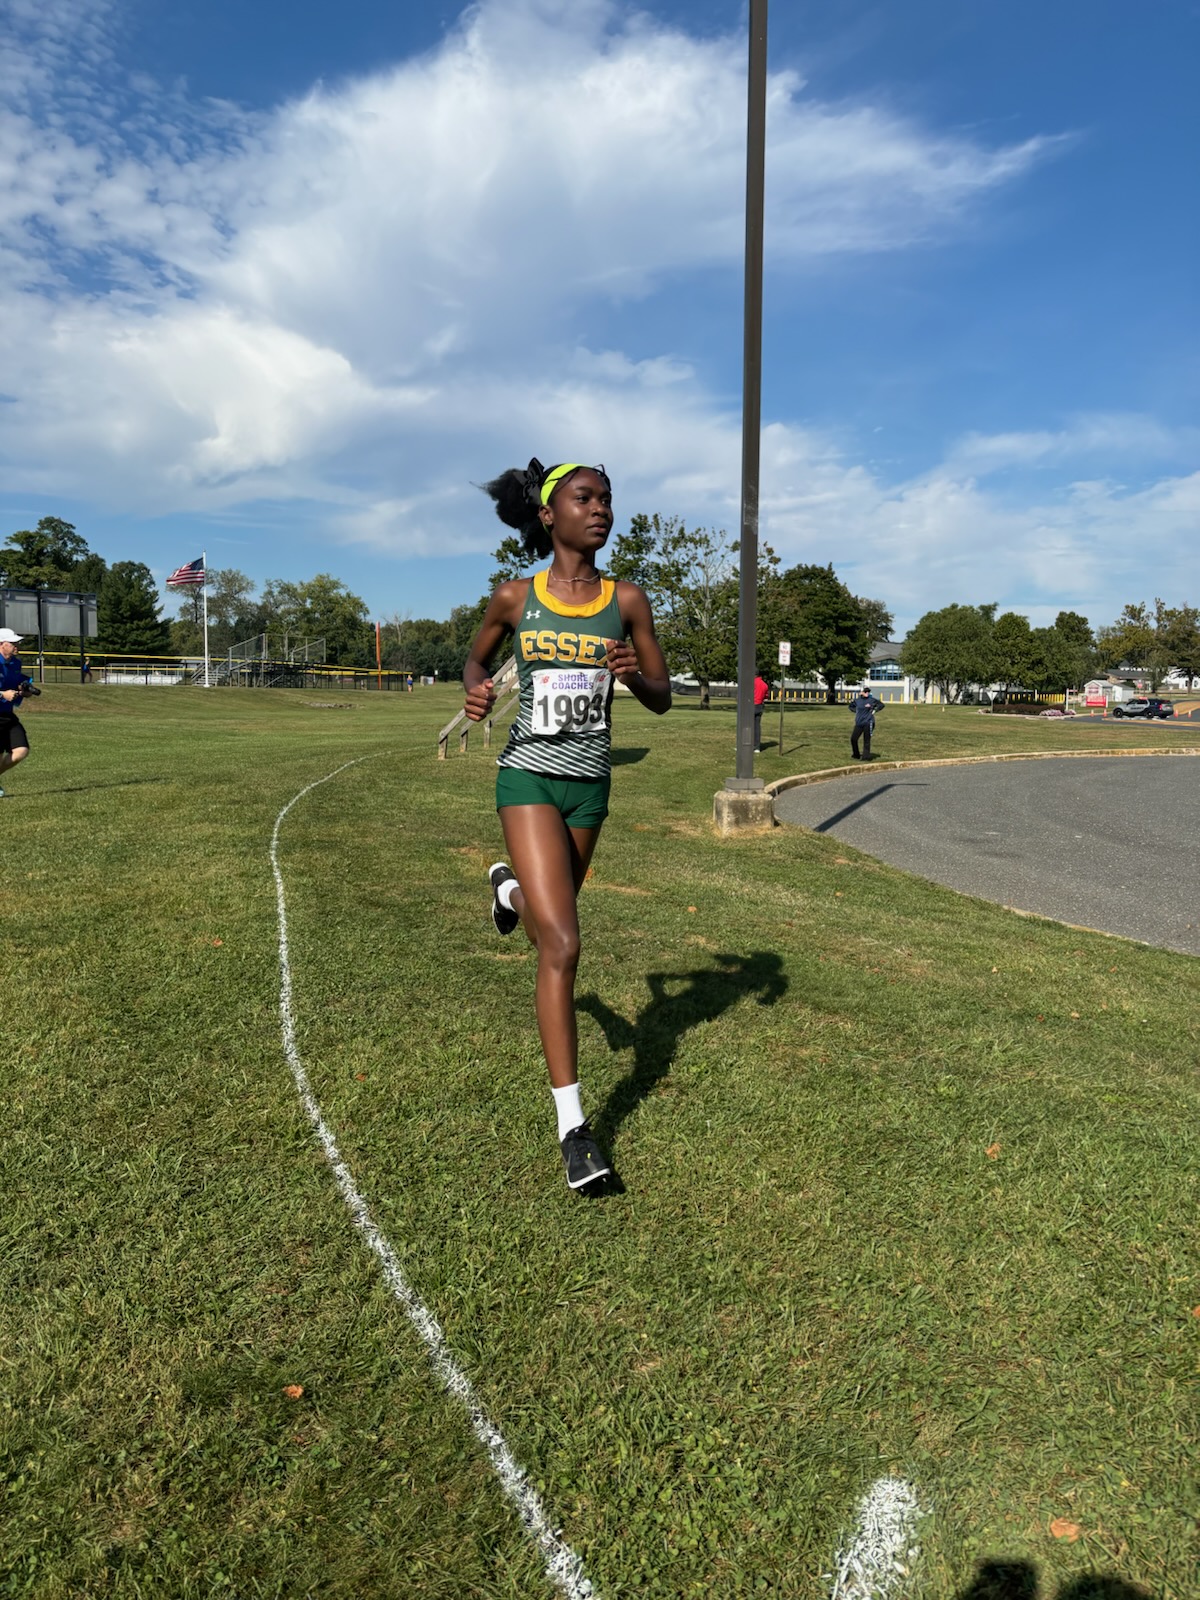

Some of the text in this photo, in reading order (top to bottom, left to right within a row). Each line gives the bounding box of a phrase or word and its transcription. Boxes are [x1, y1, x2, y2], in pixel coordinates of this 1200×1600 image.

[558, 674, 589, 682] SHORE
[551, 682, 594, 690] COACHES
[537, 693, 604, 729] 1993
